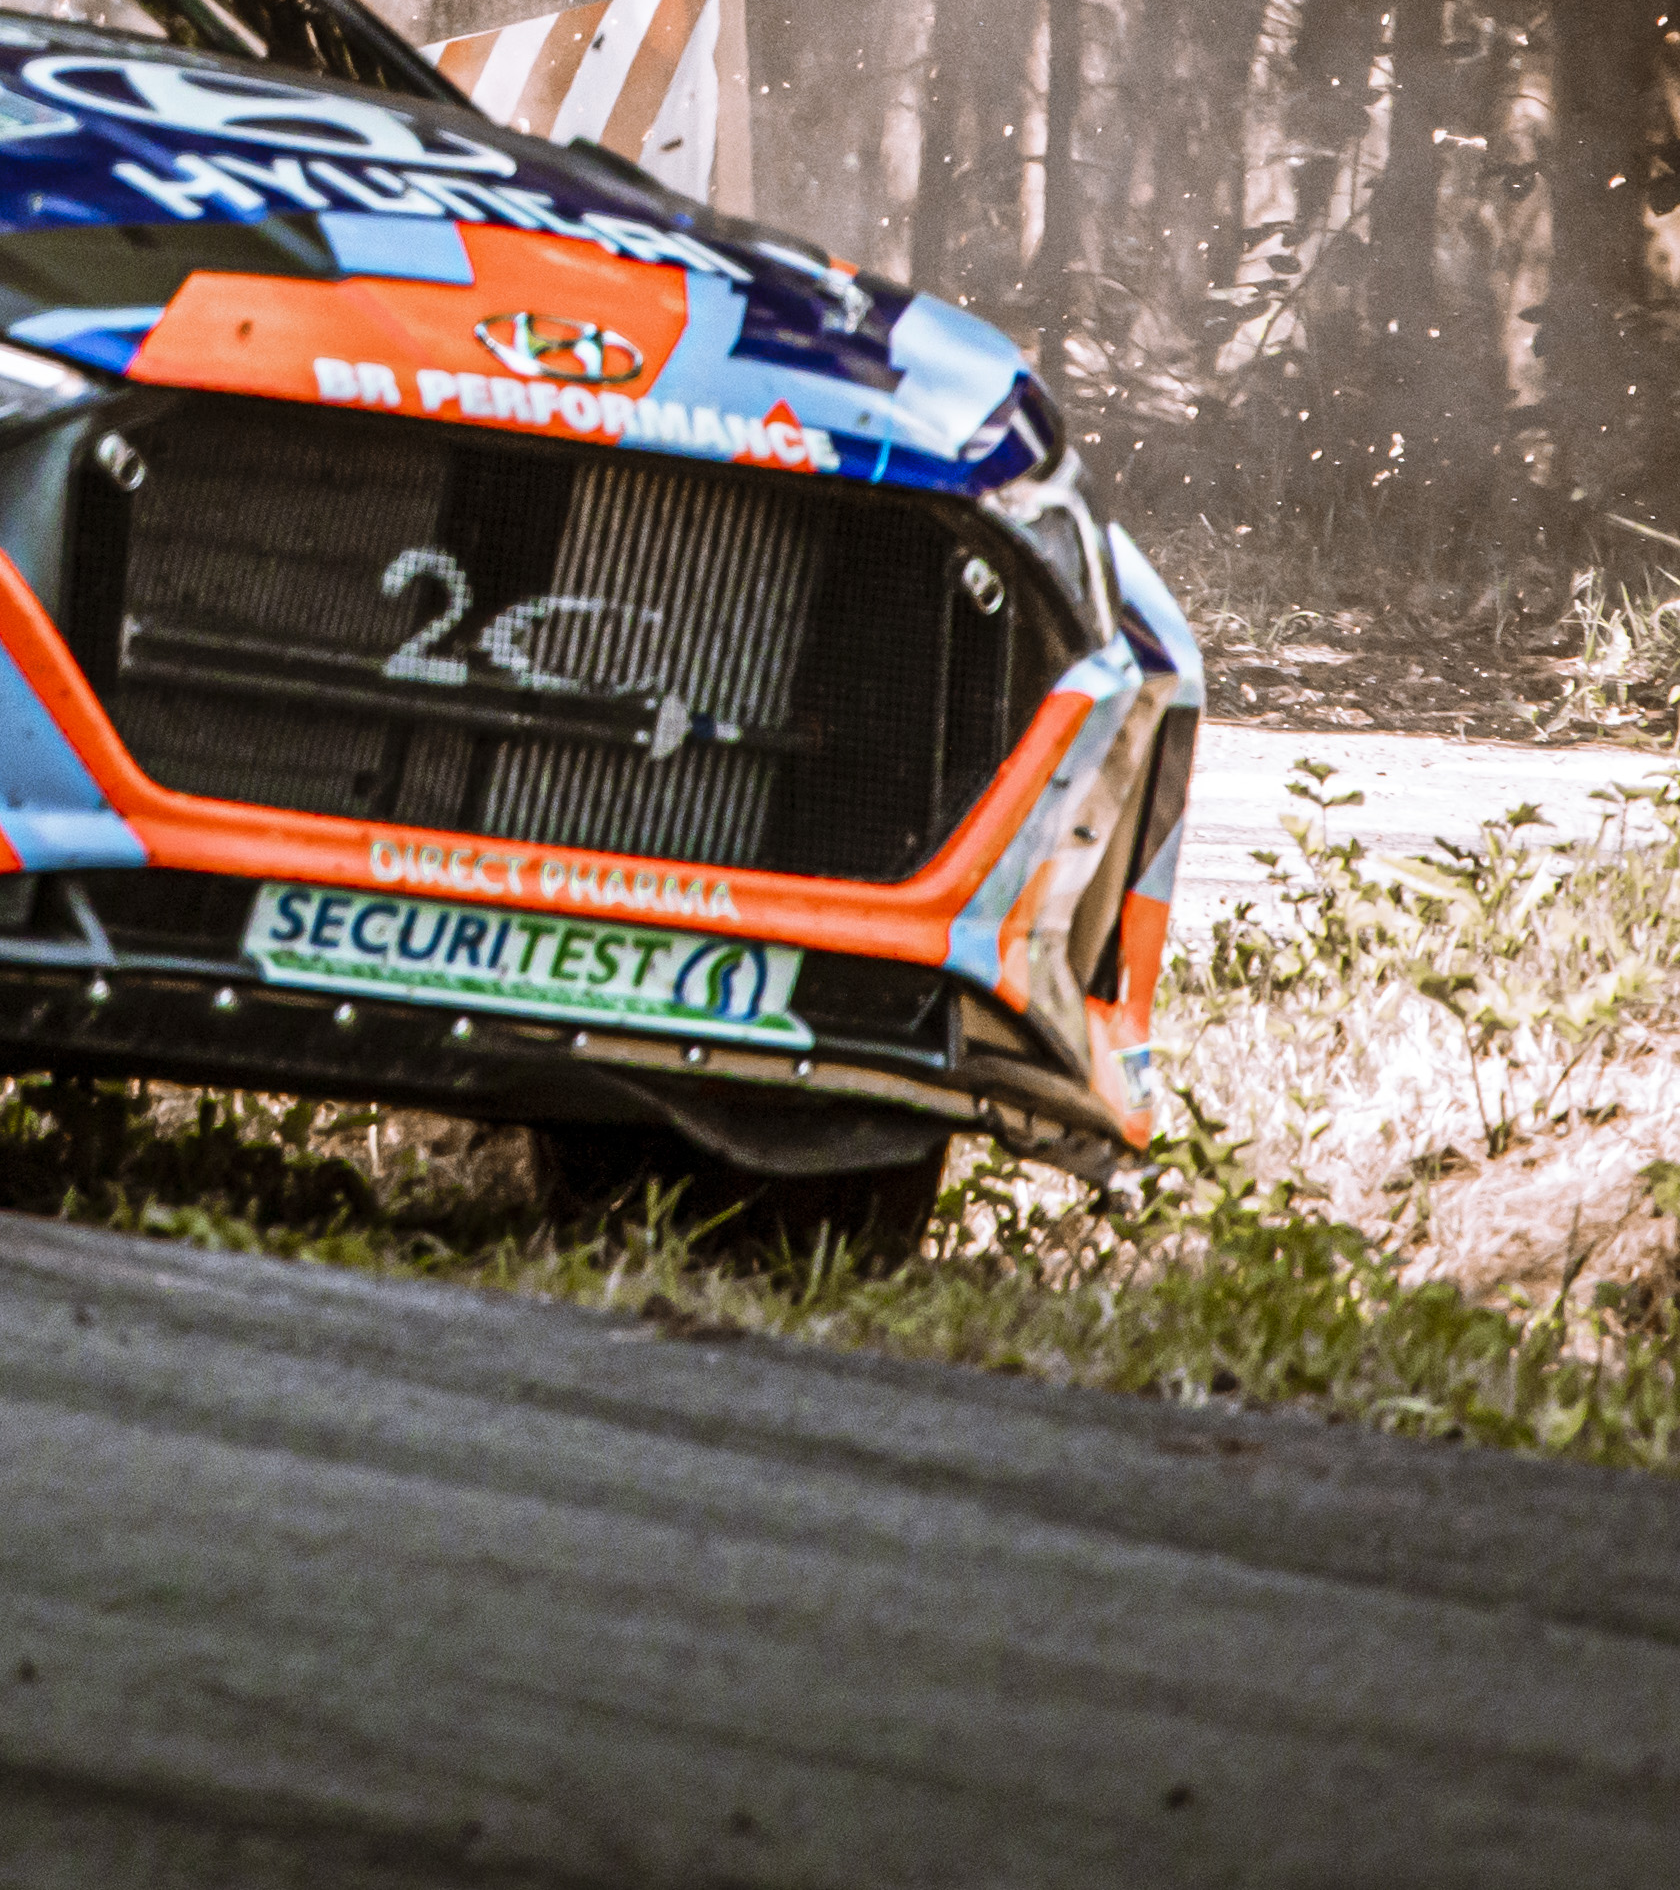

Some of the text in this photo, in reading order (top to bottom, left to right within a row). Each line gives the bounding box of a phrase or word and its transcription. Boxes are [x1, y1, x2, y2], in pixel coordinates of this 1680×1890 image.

[312, 354, 842, 472] BR PERFORMANCE
[369, 839, 742, 921] DIRECT PHARMA
[269, 890, 674, 989] SECURITEST
